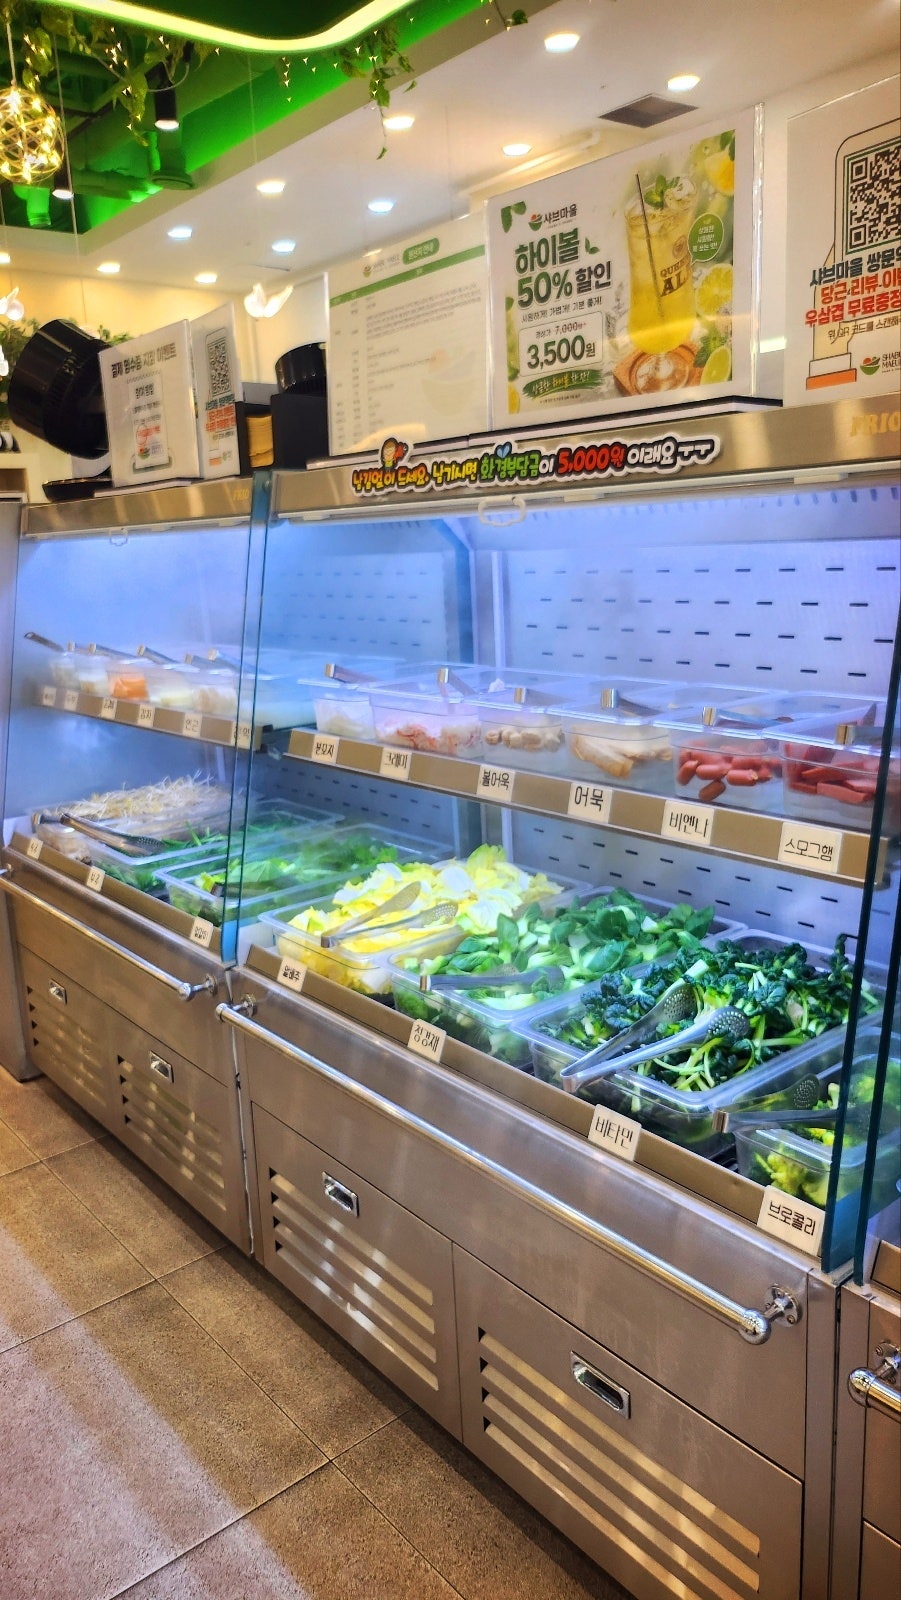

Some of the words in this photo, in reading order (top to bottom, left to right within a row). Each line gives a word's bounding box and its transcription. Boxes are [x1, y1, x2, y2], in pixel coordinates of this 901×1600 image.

[543, 203, 578, 223] 샤브마을
[515, 227, 580, 274] 하이볼
[517, 269, 573, 308] 50%
[575, 260, 612, 295] 할인
[810, 257, 863, 287] 샤브마을
[805, 302, 844, 328] 우삼겹
[123, 356, 142, 374] 영수증
[526, 334, 597, 370] 3,500원
[352, 469, 395, 491] 남김없이
[432, 461, 478, 484] 남기시면
[480, 453, 554, 480] 환경부담금이
[557, 444, 625, 473] 5,000원
[315, 742, 335, 758] 분모자
[384, 752, 408, 769] 크래미
[574, 785, 604, 812] 어묵
[669, 812, 709, 838] 비엔나
[783, 838, 833, 862] 스모그햄
[595, 1116, 634, 1149] 비타민
[767, 1200, 817, 1236] 브로콜리
